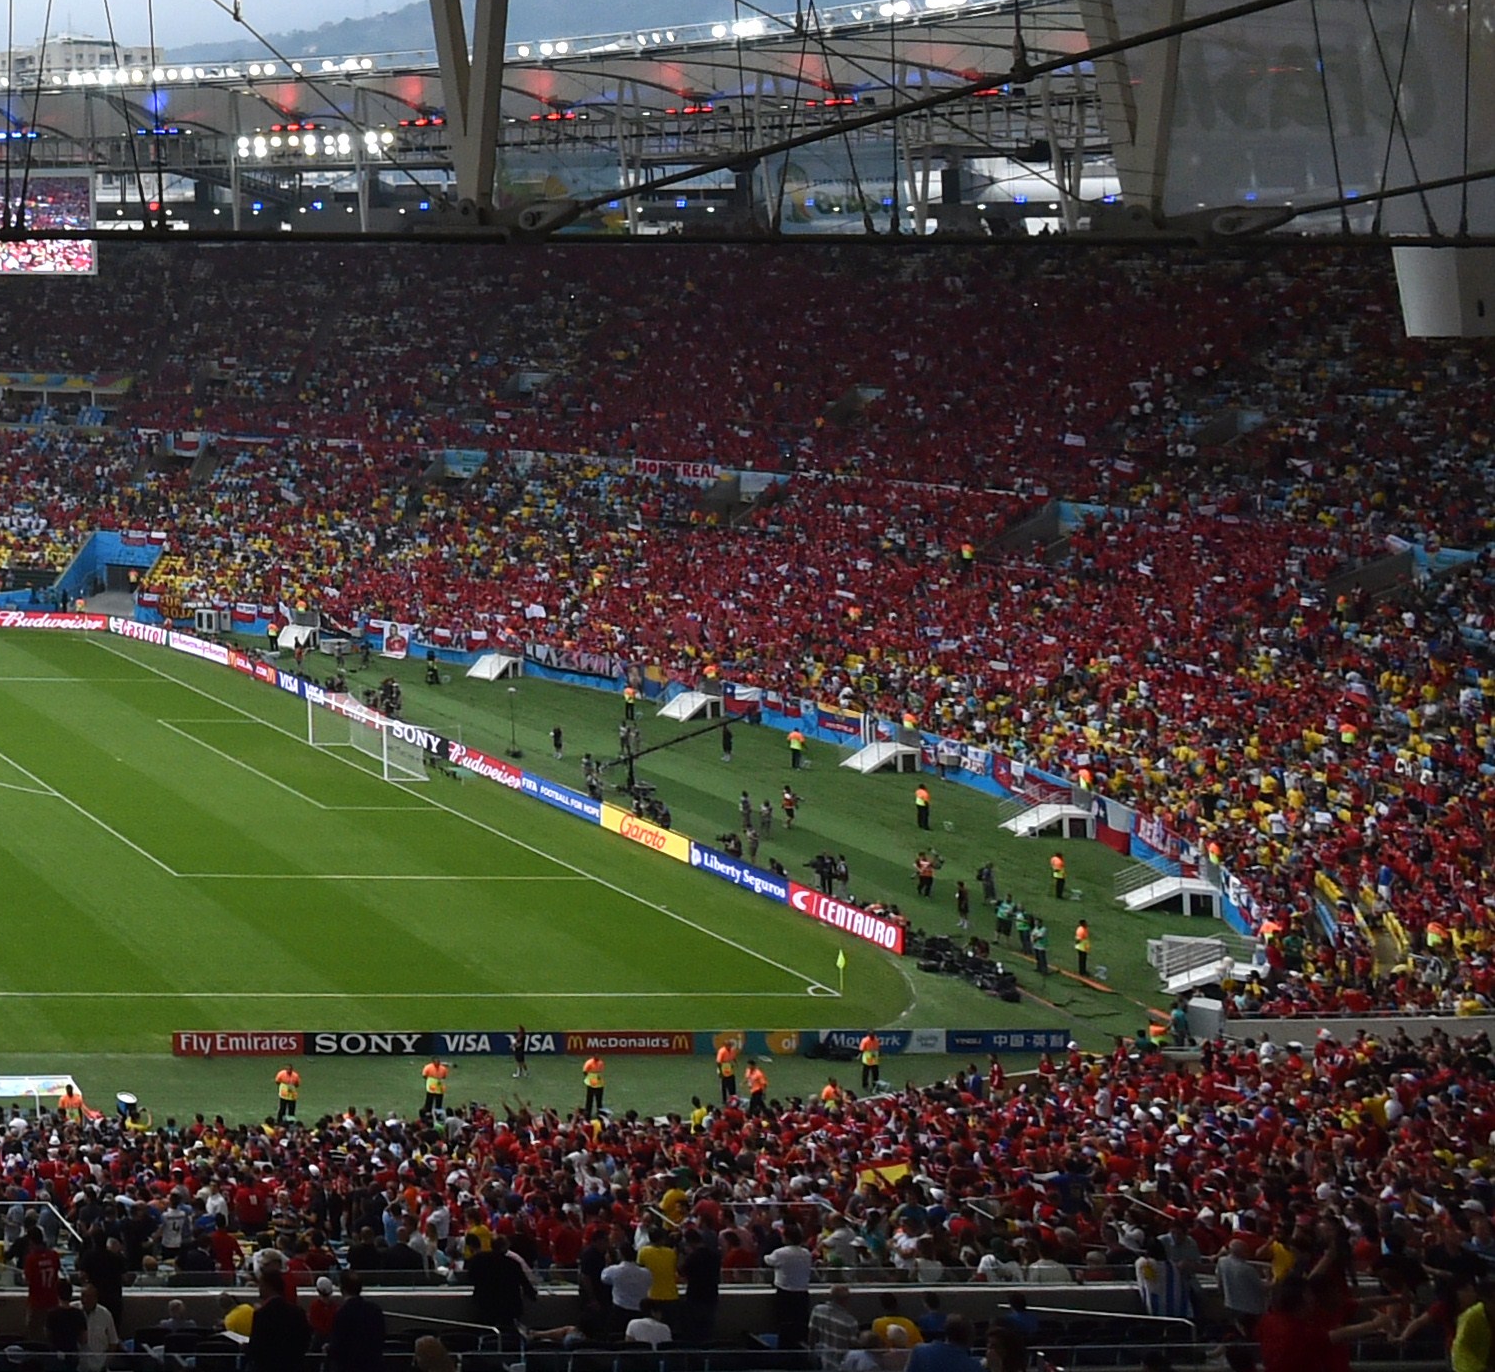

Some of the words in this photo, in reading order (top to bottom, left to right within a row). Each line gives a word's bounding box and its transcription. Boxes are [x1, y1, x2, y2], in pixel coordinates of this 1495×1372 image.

[121, 620, 168, 645] Castrol
[278, 671, 299, 694] VISA
[392, 720, 441, 754] SONY
[448, 741, 521, 790] Budweiser
[522, 777, 538, 794] FIFA
[540, 785, 570, 807] FOOTBALL
[571, 797, 583, 812] FOR
[584, 802, 599, 818] HOPE
[620, 815, 666, 849] Garoto
[704, 855, 741, 883] Liberty
[743, 870, 786, 899] Seguros
[819, 898, 896, 948] CENTAURO
[180, 1033, 211, 1055] Fly
[216, 1032, 297, 1052] Emirates
[314, 1034, 422, 1053] SONY
[442, 1034, 491, 1052] VISA
[586, 1035, 670, 1048] McDonald's
[781, 1033, 796, 1049] oi
